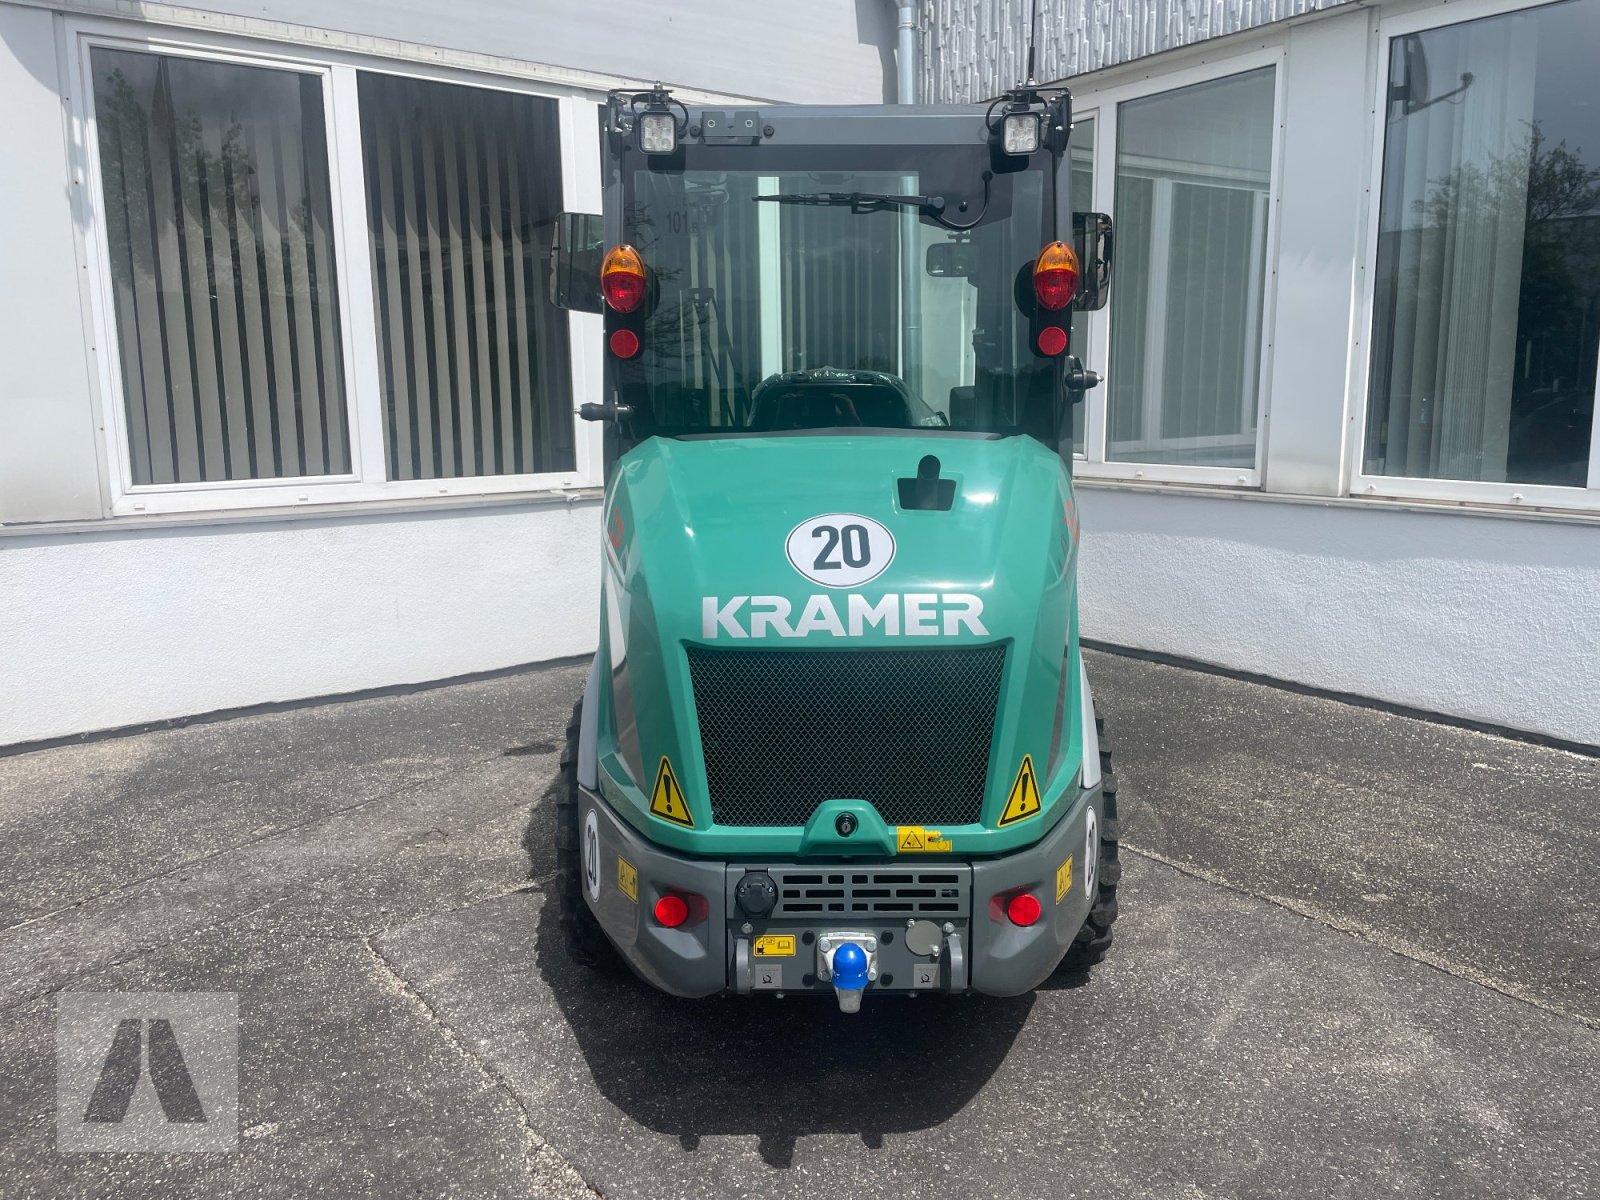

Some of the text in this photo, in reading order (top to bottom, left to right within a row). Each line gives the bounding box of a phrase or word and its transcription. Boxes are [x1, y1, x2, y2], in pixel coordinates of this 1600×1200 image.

[666, 210, 688, 233] 101
[811, 524, 871, 570] 20
[702, 593, 991, 639] KRAMER
[587, 824, 597, 887] 20
